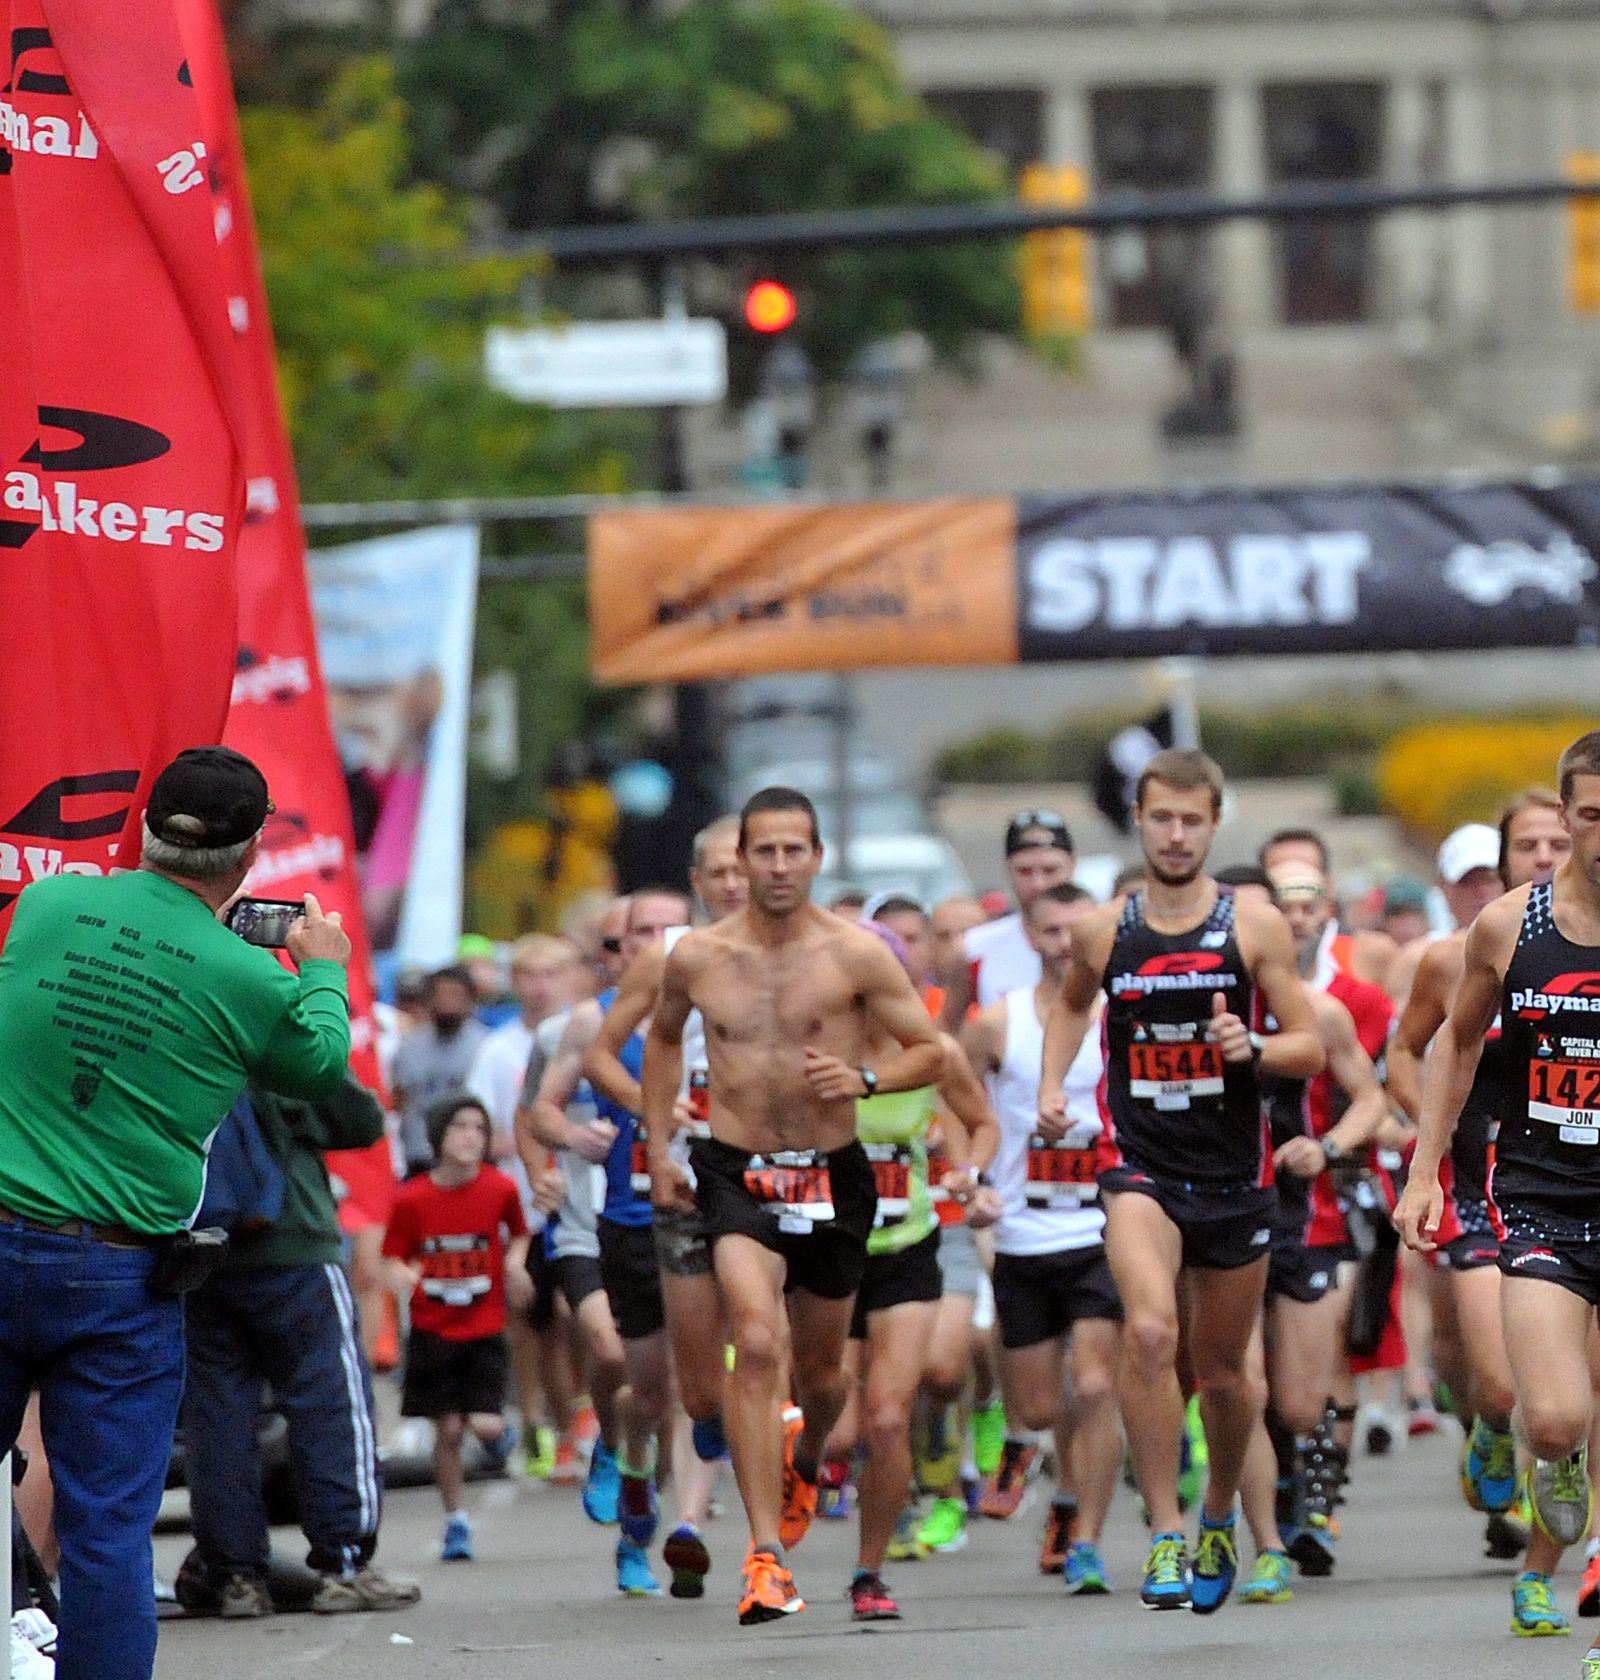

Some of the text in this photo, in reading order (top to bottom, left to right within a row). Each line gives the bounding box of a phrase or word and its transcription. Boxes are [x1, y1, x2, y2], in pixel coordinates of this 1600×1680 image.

[1028, 534, 1371, 632] START
[111, 941, 146, 960] Meijer
[155, 939, 196, 964] The Bay
[64, 950, 180, 999] Blue Cross Blue Shield
[1112, 971, 1237, 995] playmakers
[56, 983, 104, 1002] Regional
[105, 996, 149, 1018] Medical
[68, 968, 92, 983] Blue
[120, 983, 163, 1009] Network
[52, 1015, 73, 1029] Two
[56, 1000, 153, 1038] Independent Bank
[1560, 1036, 1595, 1049] CAPITAL
[1565, 1047, 1591, 1058] RIVER
[1136, 1047, 1216, 1081] 1544
[1566, 1111, 1593, 1126] JON
